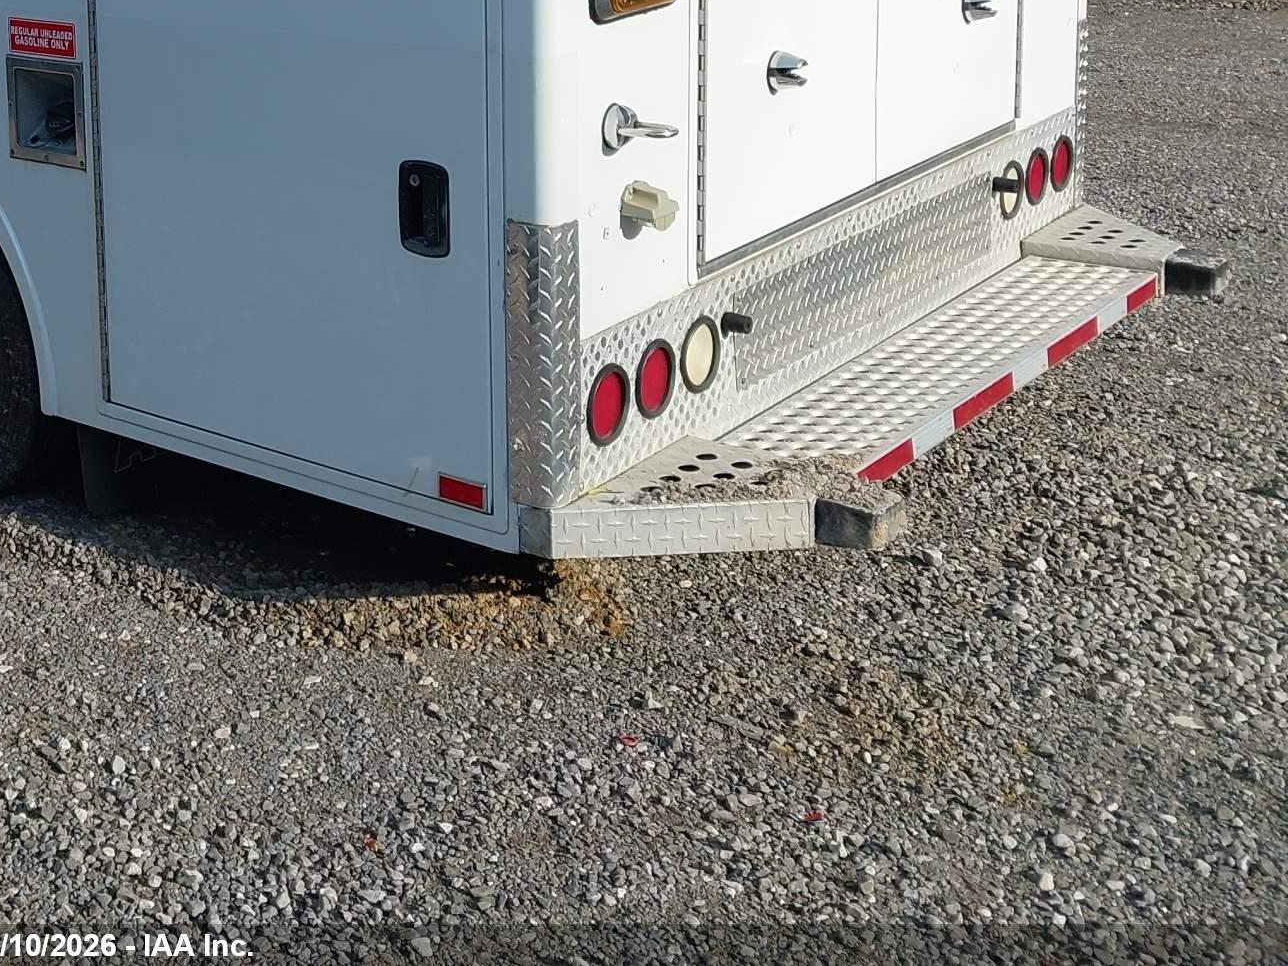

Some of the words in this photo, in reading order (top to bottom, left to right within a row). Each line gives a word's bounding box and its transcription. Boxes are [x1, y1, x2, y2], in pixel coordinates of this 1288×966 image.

[11, 26, 39, 37] REGULAR
[40, 29, 72, 40] UNLEADED
[14, 35, 50, 48] GASOLINE
[51, 39, 69, 50] ONLY
